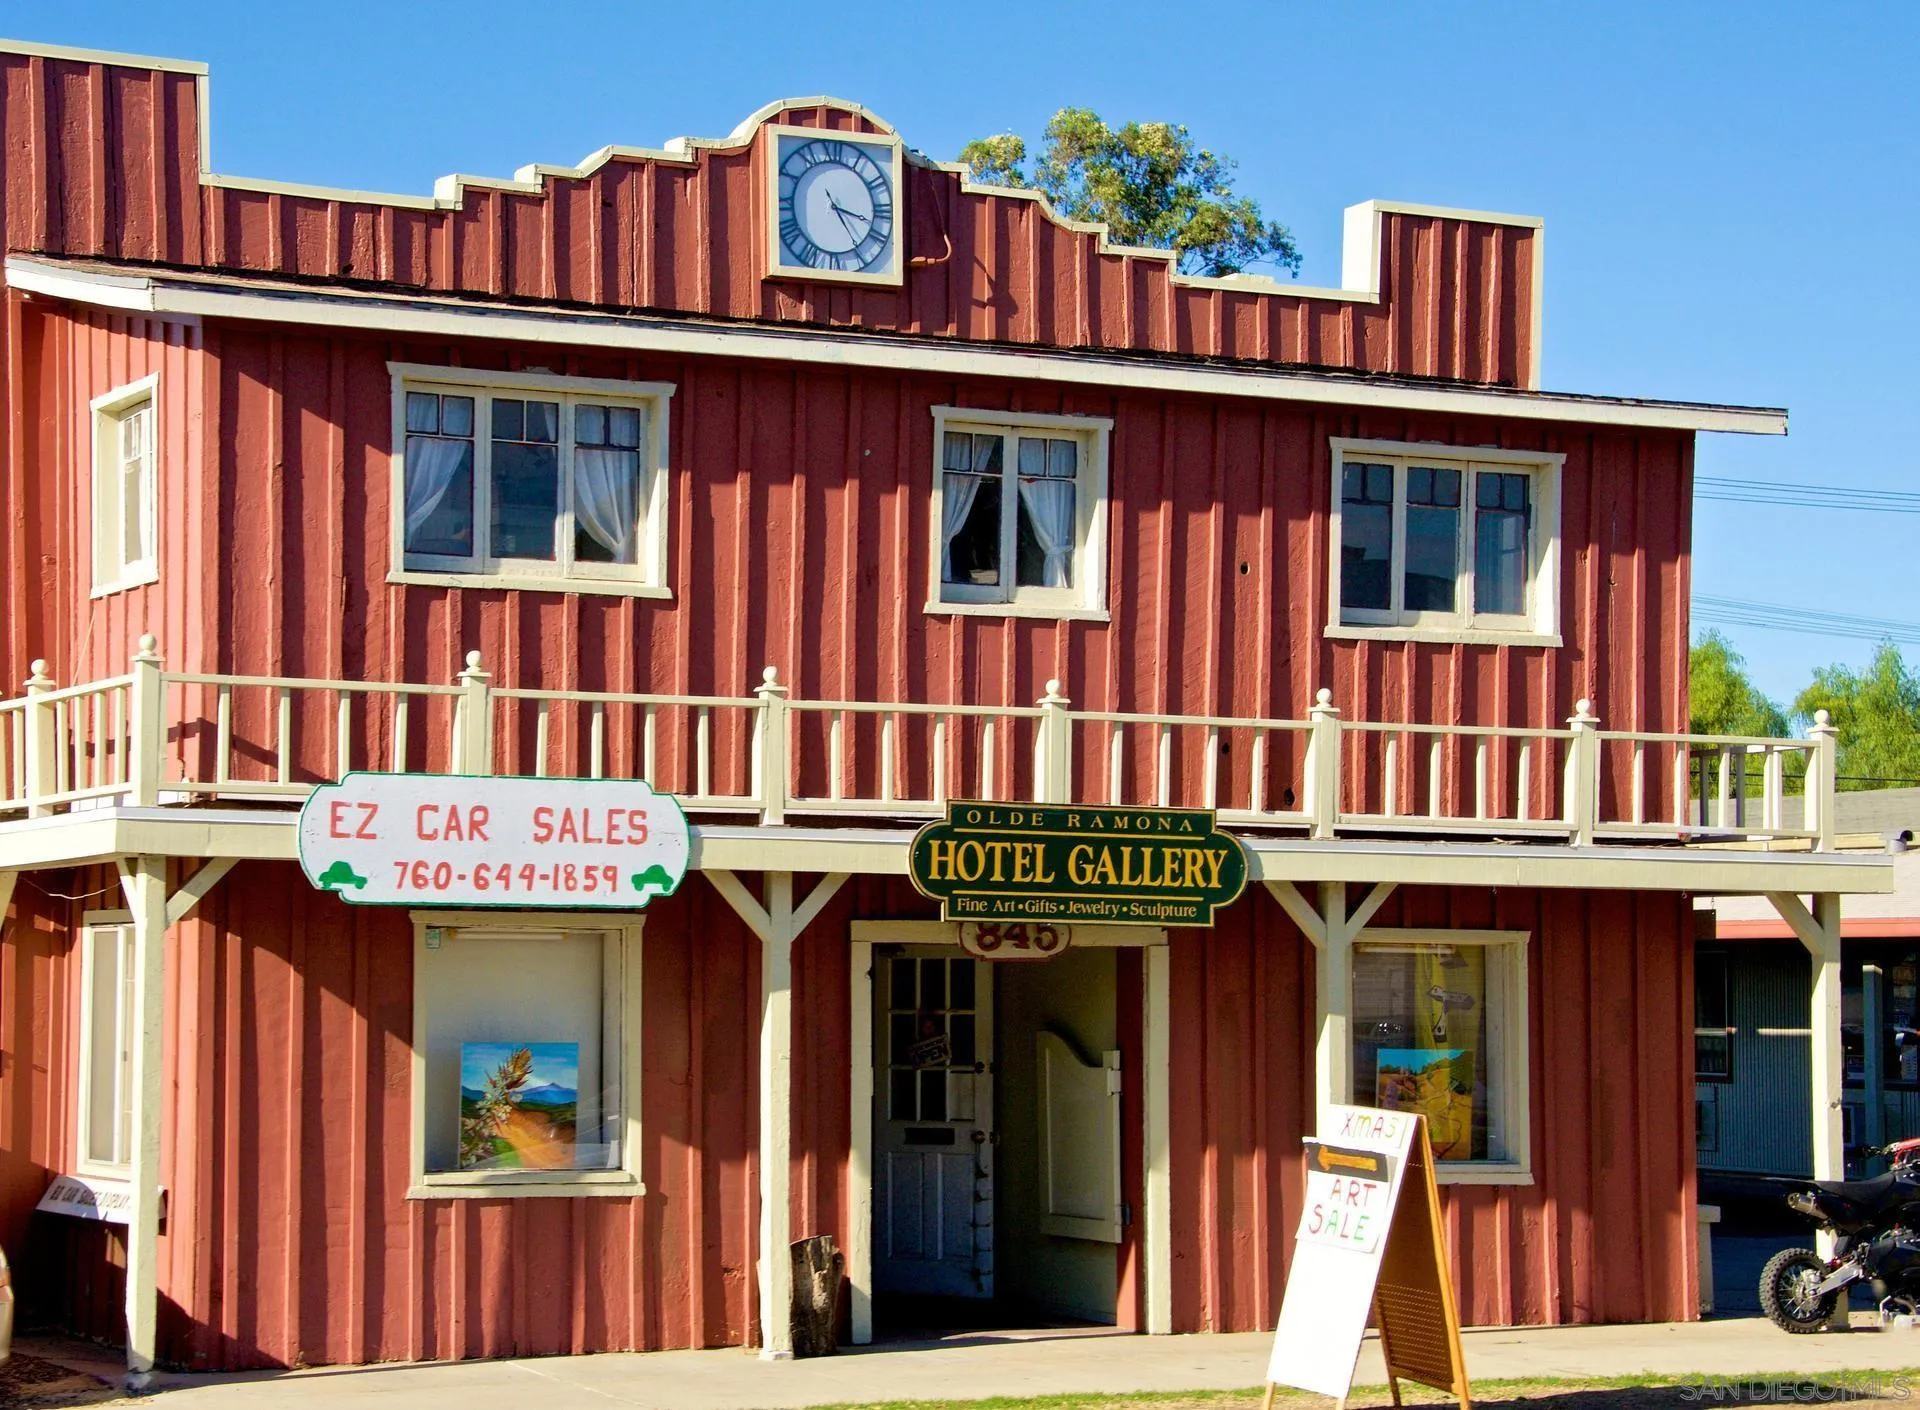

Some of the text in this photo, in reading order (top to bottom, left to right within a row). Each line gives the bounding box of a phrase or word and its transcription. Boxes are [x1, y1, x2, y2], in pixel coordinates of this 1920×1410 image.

[329, 800, 649, 845] EZ CAR SALES
[966, 809, 1193, 832] OLDE RAMONA
[393, 860, 619, 893] 760-644-1859
[928, 839, 1229, 888] HOTEL GALLERY
[957, 897, 1198, 919] Fine Art Gifts Jewelry Sculpture
[976, 922, 1059, 952] 845
[1331, 1178, 1377, 1208] ART
[1308, 1203, 1370, 1241] SALE
